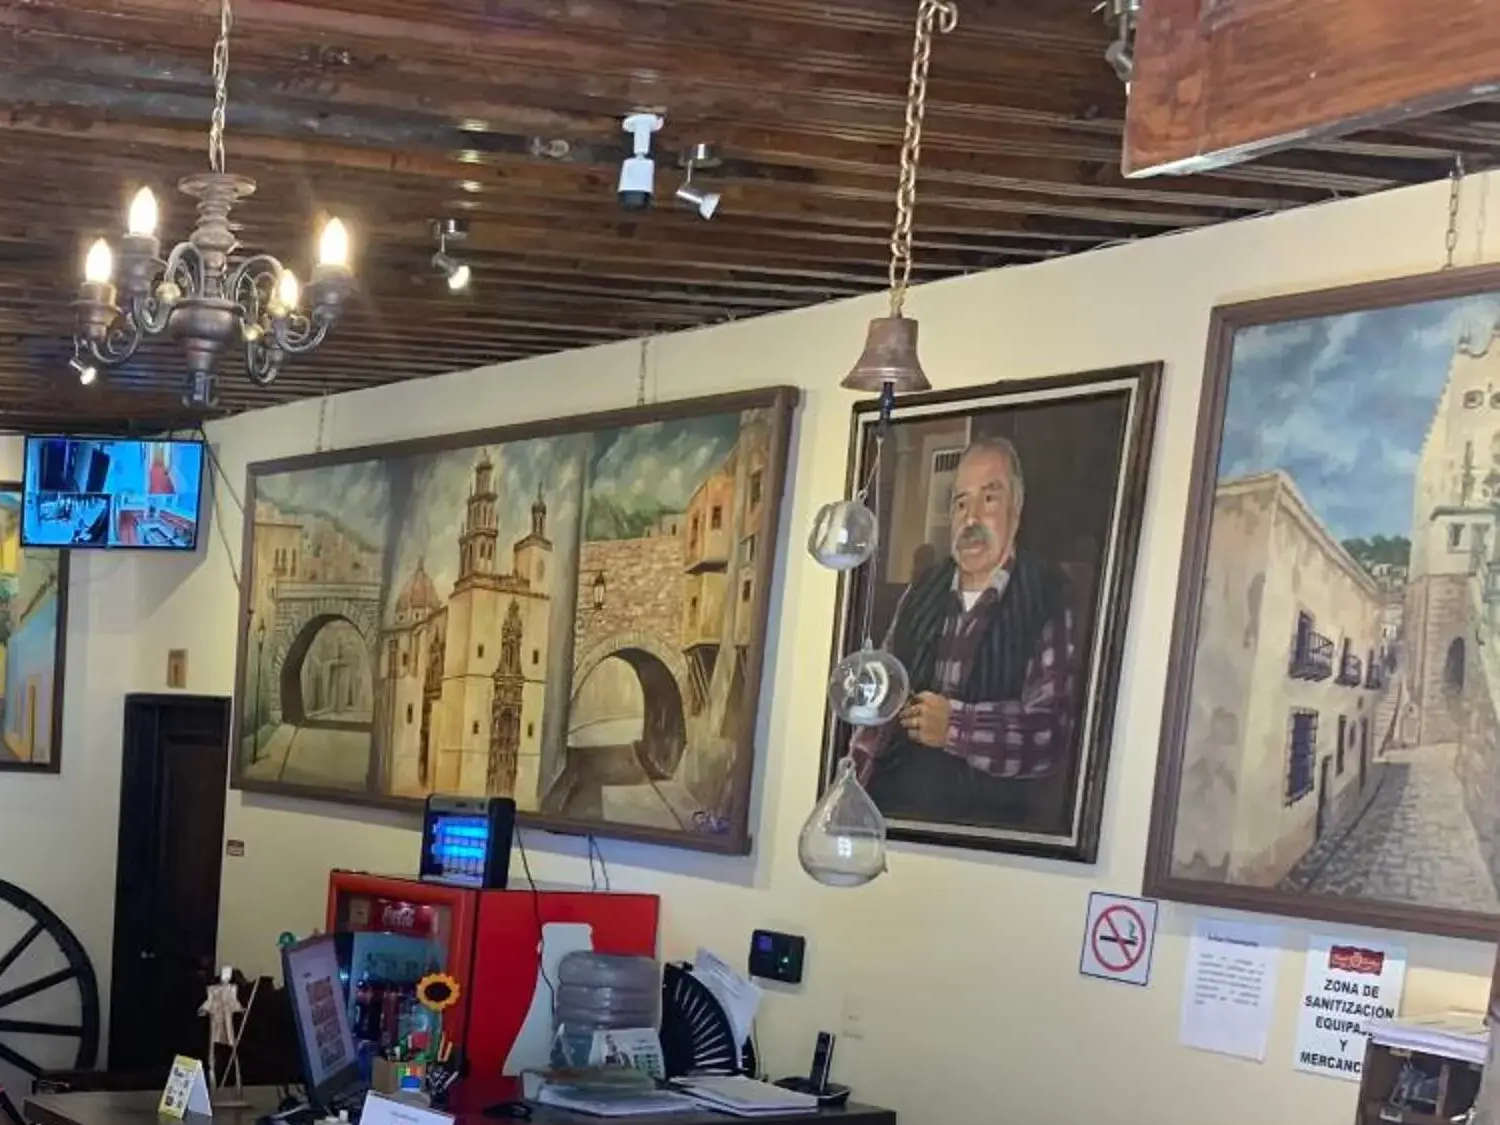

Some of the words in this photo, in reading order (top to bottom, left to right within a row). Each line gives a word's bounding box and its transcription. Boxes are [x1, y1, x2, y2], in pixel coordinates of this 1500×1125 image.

[1324, 979, 1359, 996] ZONA
[1362, 985, 1380, 999] DE
[1339, 1039, 1349, 1053] Y
